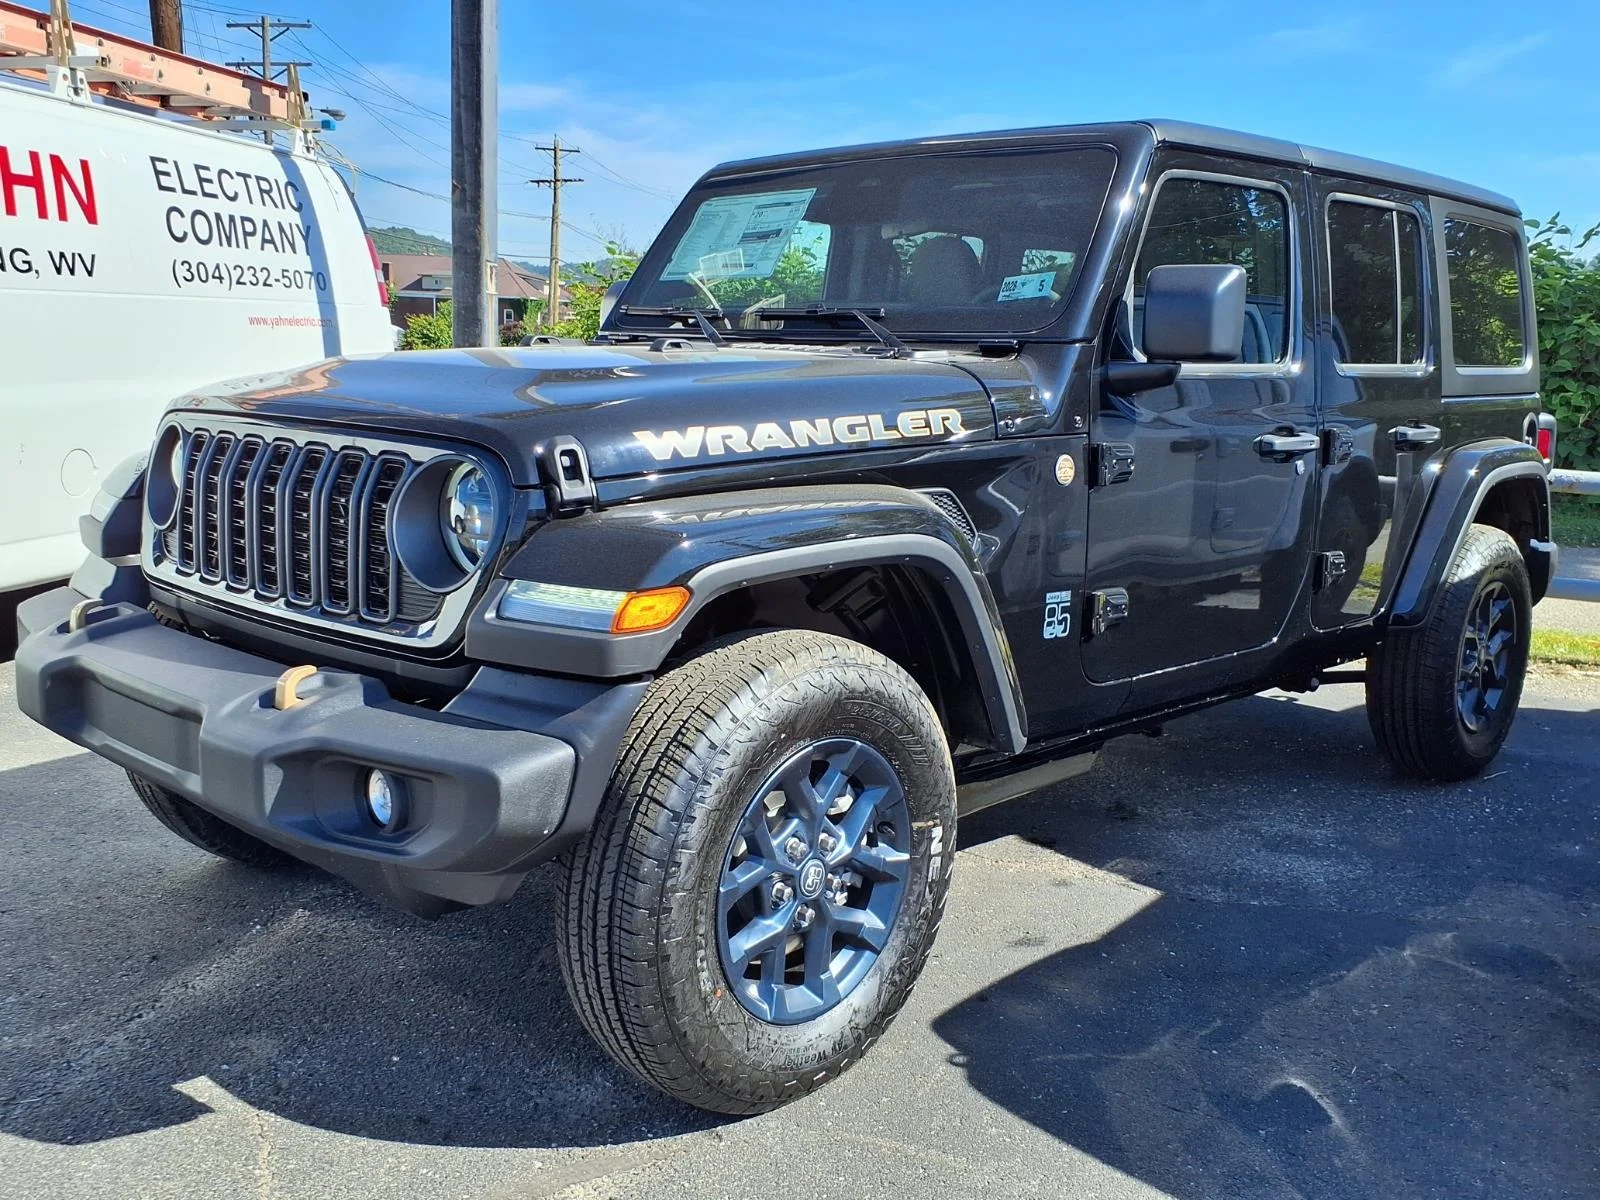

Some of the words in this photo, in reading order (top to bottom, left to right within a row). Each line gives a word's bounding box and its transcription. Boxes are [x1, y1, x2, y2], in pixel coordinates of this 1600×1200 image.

[149, 155, 304, 213] ELECTRIC
[165, 205, 312, 257] COMPANY
[47, 250, 96, 278] WV
[172, 258, 327, 292] (304)232-5070
[1038, 279, 1046, 292] 5
[632, 408, 968, 461] WRANGLER
[1043, 602, 1070, 639] 85
